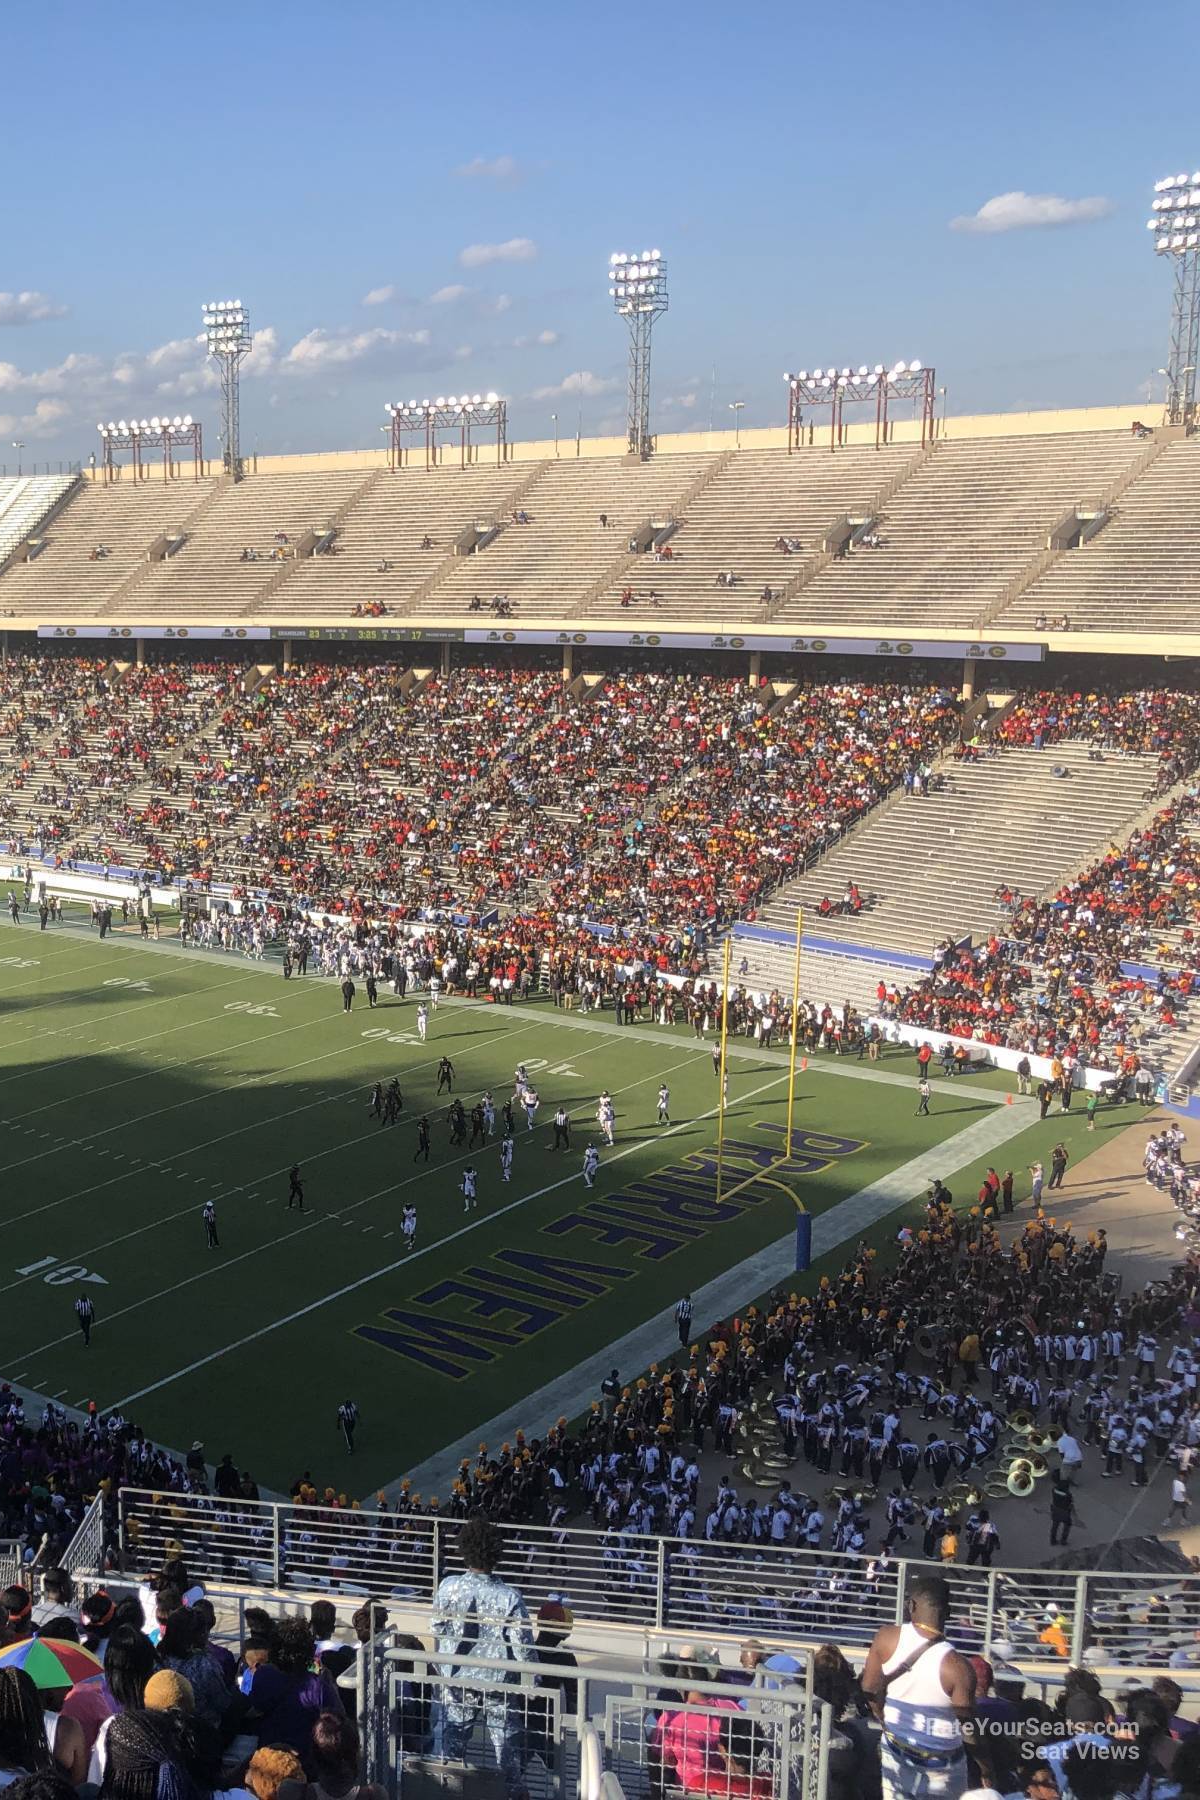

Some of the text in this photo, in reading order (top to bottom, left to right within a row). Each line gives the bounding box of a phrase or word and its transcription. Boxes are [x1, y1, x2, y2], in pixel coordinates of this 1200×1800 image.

[309, 630, 320, 639] 23
[358, 630, 377, 639] 3:25
[412, 631, 422, 640] 17
[223, 1001, 278, 1016] 30
[361, 1027, 421, 1044] 20
[517, 1058, 575, 1076] 10
[349, 1121, 871, 1382] PRAIRIE VIEW
[15, 1256, 88, 1285] 10
